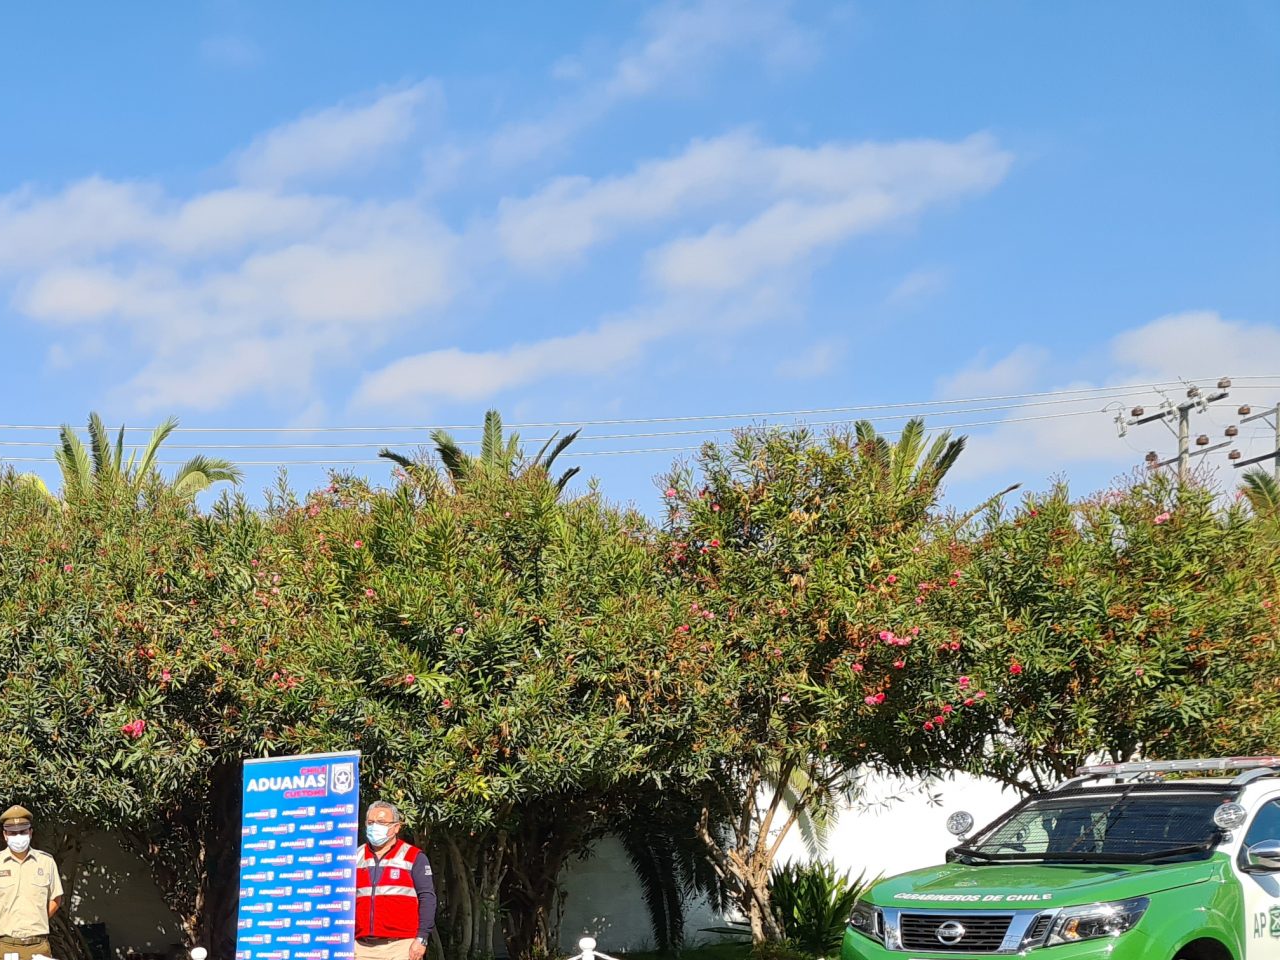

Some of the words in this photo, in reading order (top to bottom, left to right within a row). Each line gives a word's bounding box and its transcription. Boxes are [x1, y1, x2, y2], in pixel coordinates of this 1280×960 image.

[246, 774, 326, 792] ADUANAS
[894, 892, 981, 901] CARABINEROS
[1254, 912, 1266, 938] AP
